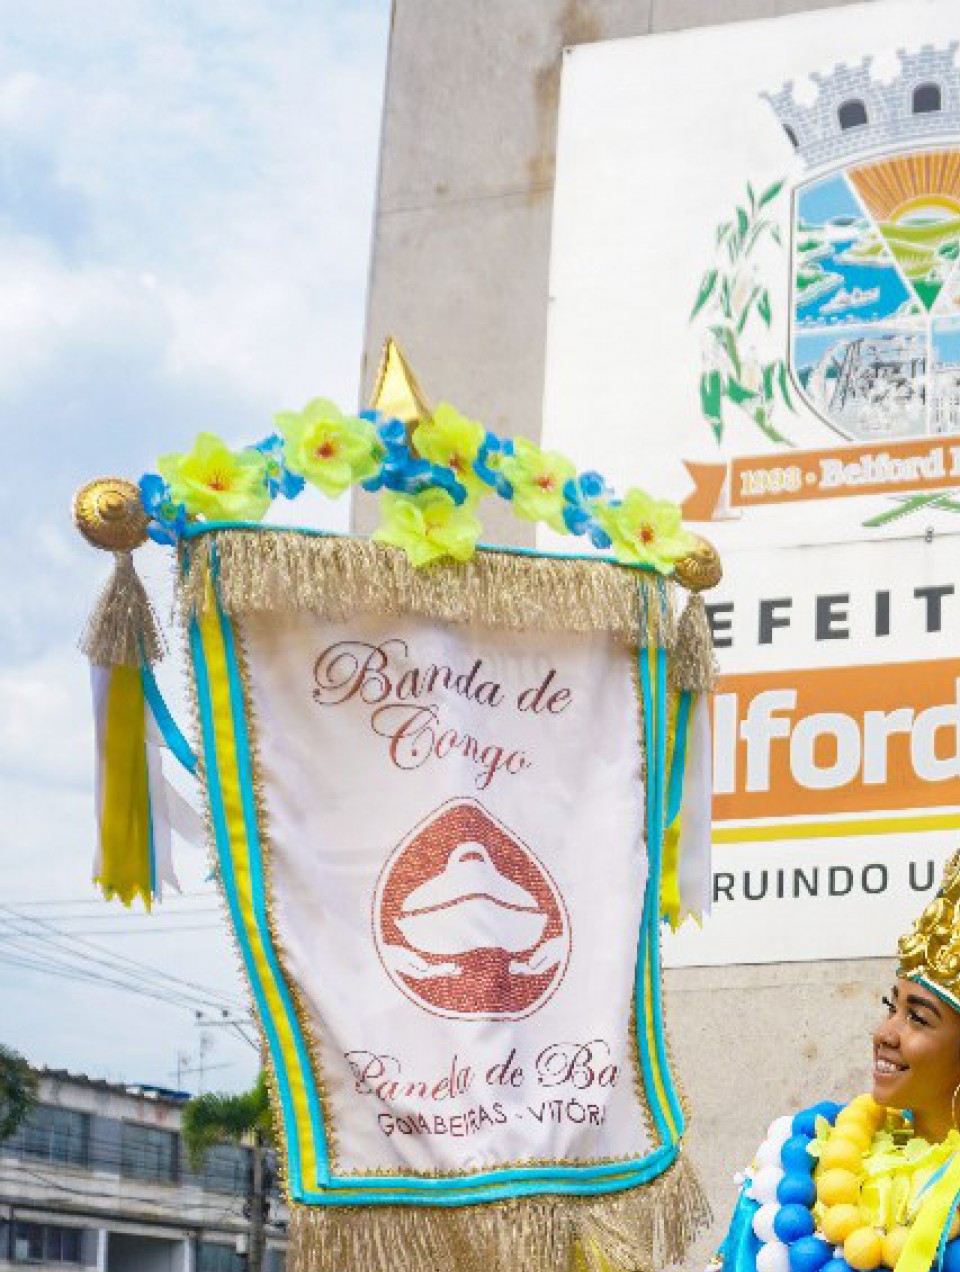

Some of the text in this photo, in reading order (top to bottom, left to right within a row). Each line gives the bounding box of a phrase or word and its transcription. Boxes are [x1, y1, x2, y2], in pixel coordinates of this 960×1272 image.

[818, 446, 947, 489] Belford
[312, 638, 573, 714] Banda de
[370, 703, 531, 791] Congo
[712, 862, 888, 903] RUINDO
[908, 860, 945, 899] U
[344, 1050, 475, 1101] Panela
[486, 1048, 524, 1088] de
[527, 1097, 607, 1127] VITÓRI
